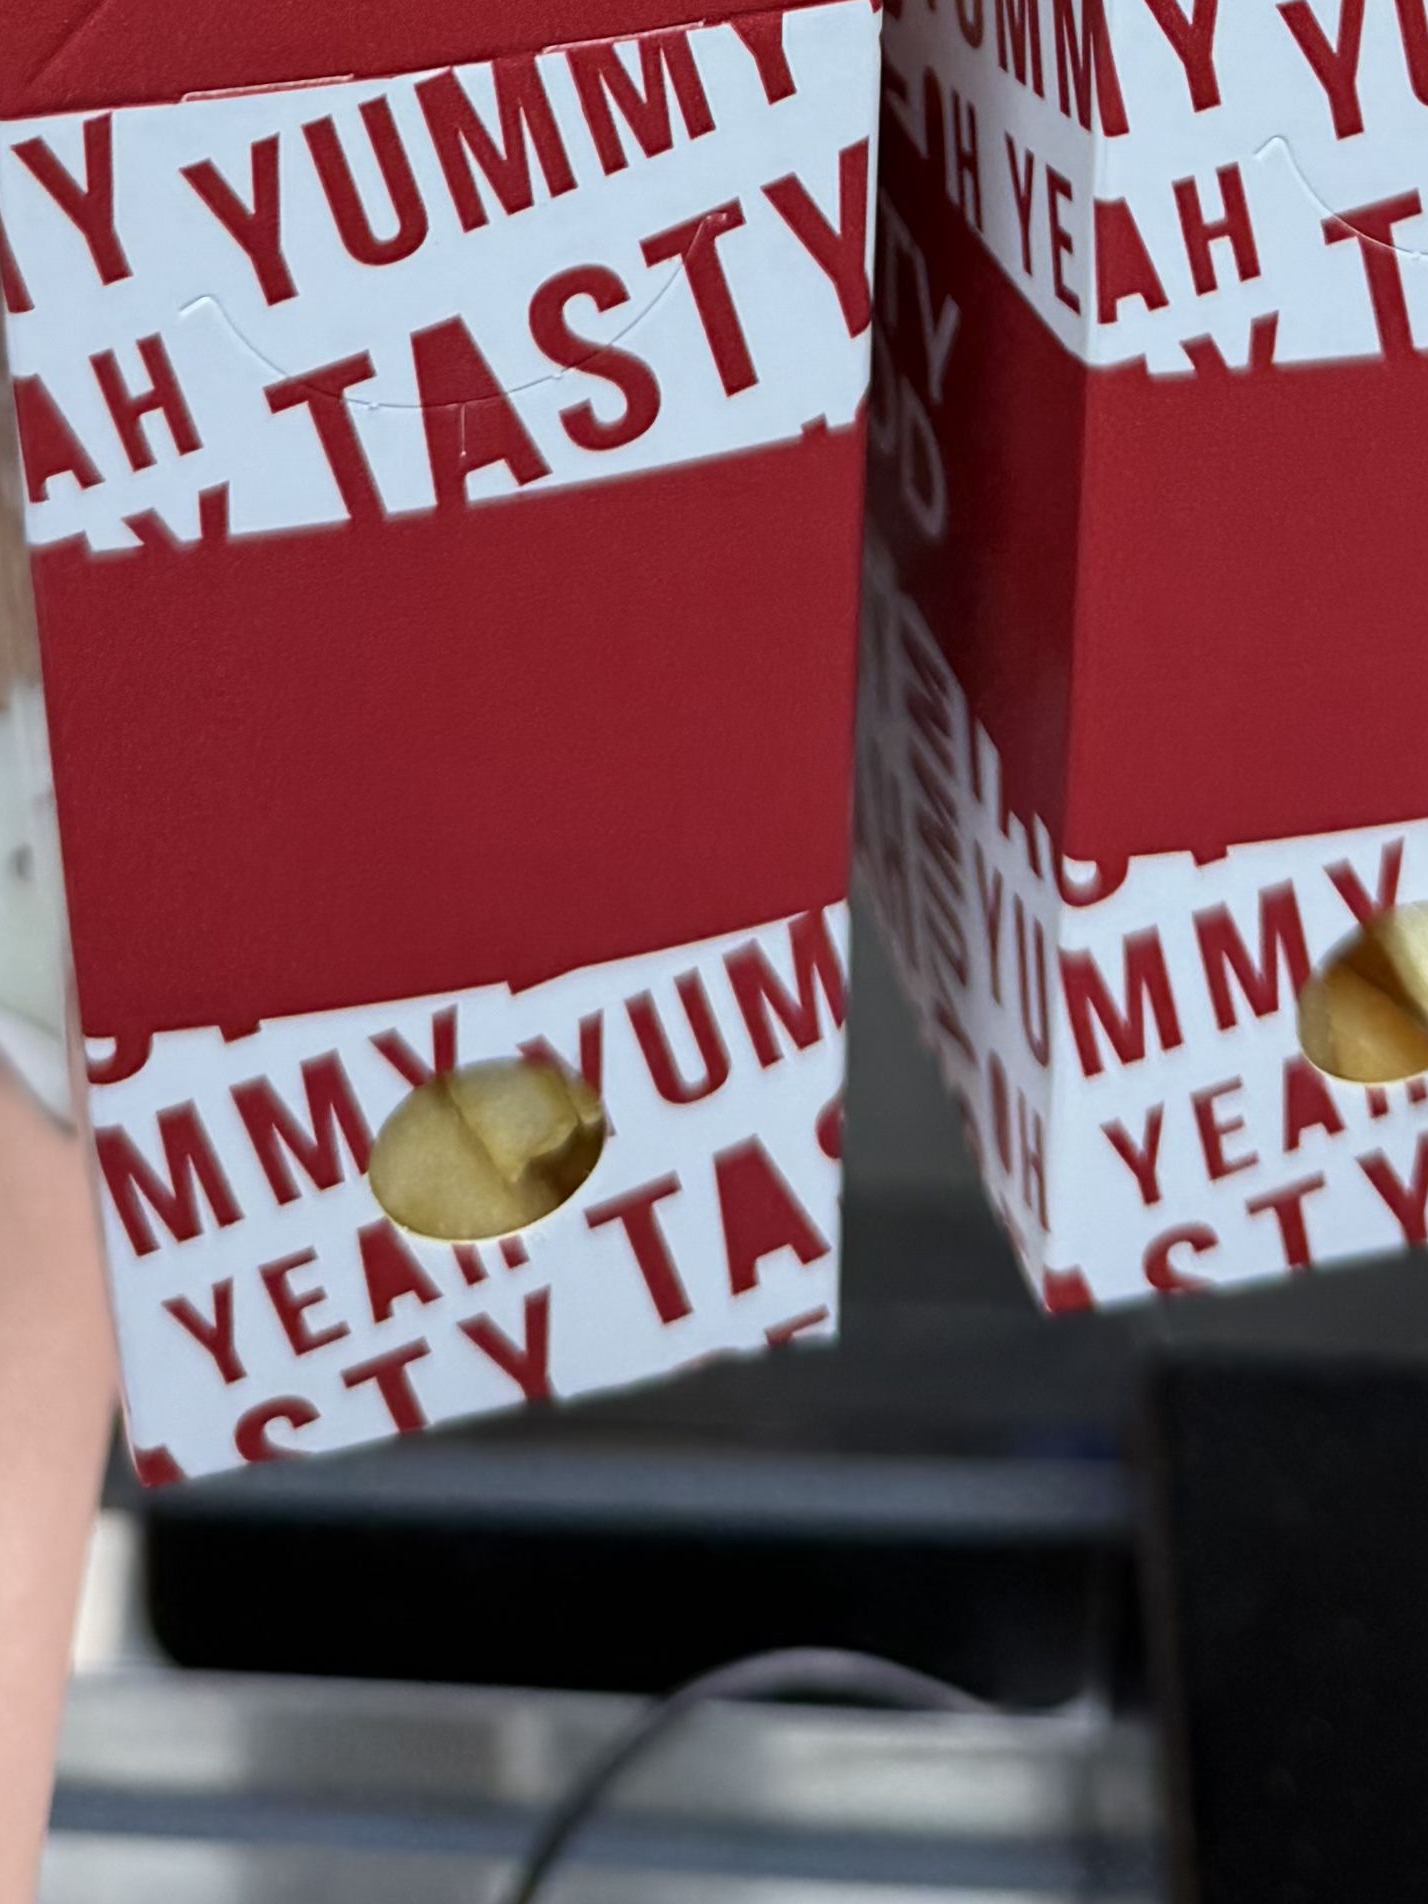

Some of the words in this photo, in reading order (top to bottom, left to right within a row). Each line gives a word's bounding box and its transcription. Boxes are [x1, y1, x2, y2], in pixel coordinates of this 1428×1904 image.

[179, 12, 797, 306] YUMMY
[1004, 132, 1262, 325] YEAH
[262, 135, 872, 520] TASTY
[163, 1218, 529, 1385] YEA
[584, 1092, 845, 1327] TA
[1101, 1052, 1428, 1206] YEA
